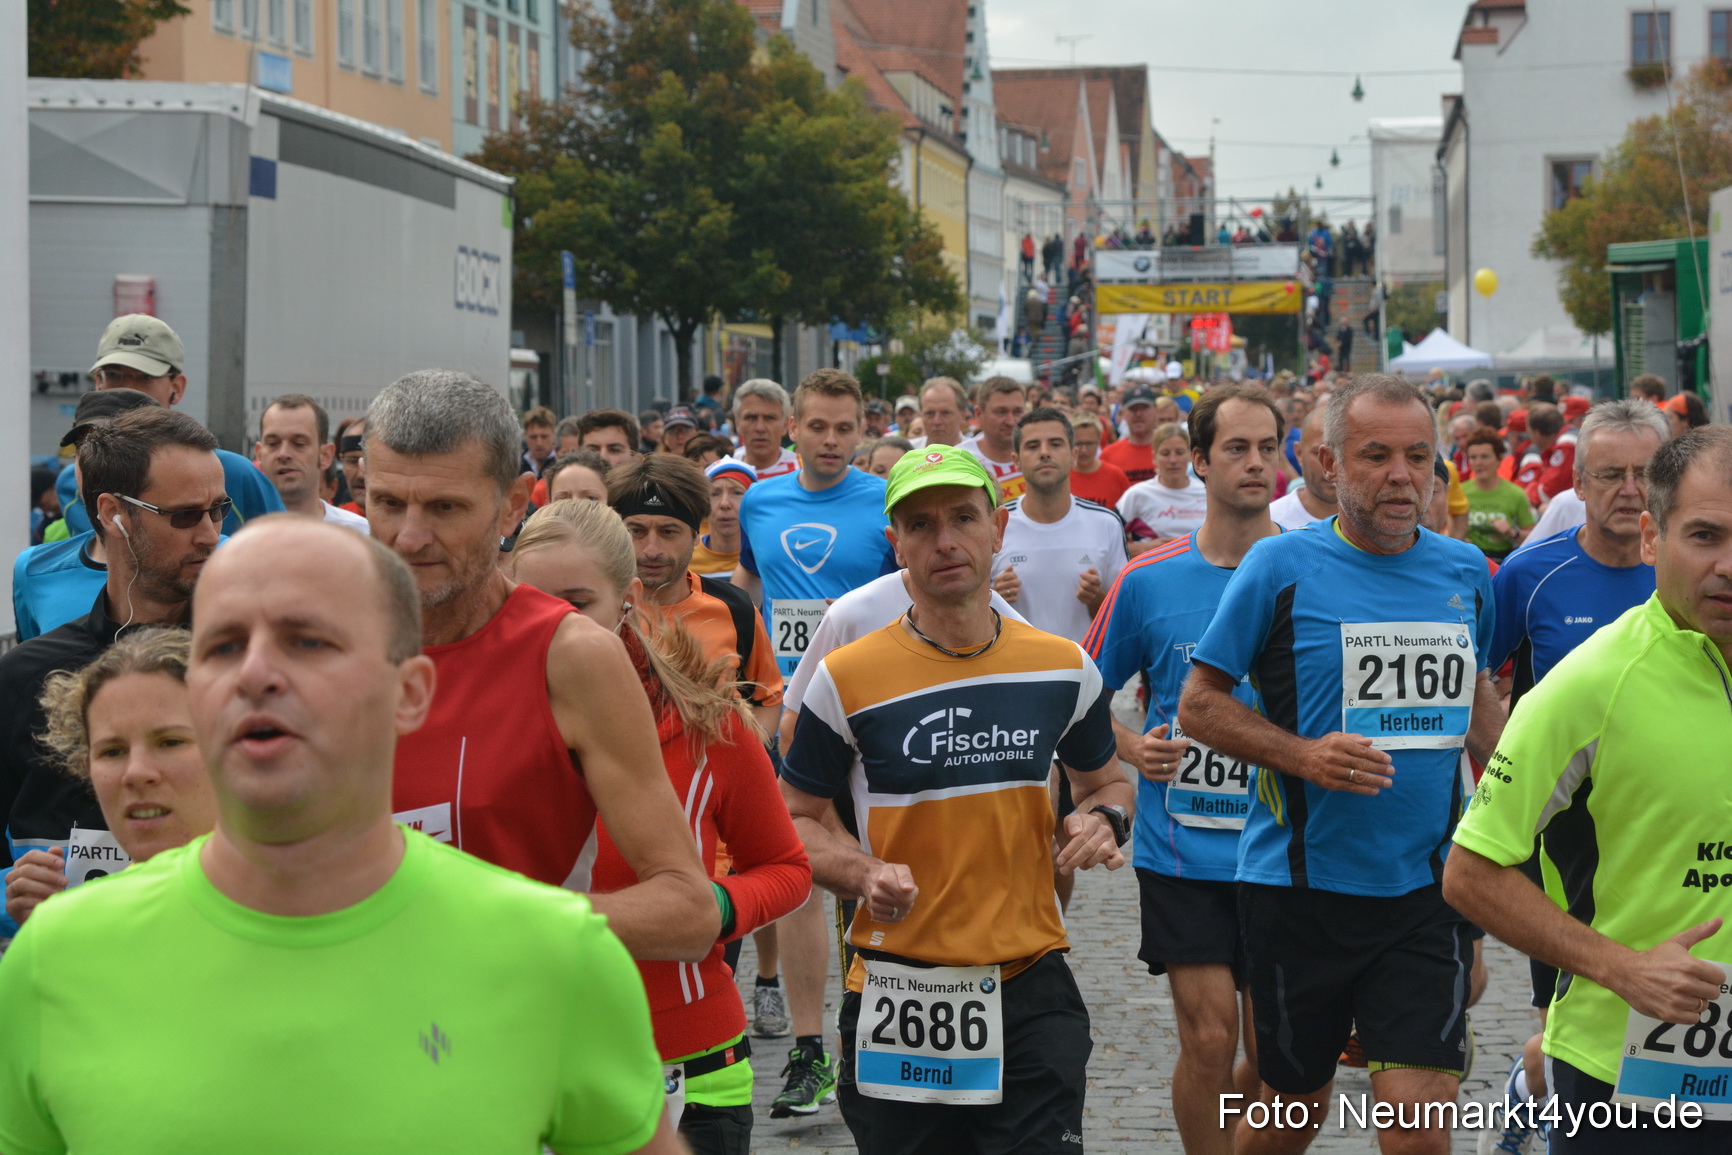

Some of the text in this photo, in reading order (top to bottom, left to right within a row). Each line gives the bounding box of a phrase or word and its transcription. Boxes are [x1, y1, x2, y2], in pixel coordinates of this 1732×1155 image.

[455, 245, 500, 316] BOCK
[1163, 289, 1232, 307] START
[773, 607, 822, 617] PARTL Neum
[1574, 616, 1593, 624] JAKO
[779, 620, 821, 652] 28
[1345, 635, 1453, 648] PARTL Neumarkt
[1358, 653, 1465, 701] 2160
[1348, 698, 1354, 707] C
[1380, 712, 1444, 732] Herbert
[931, 724, 1040, 756] Fischer
[943, 750, 1034, 768] AUTOMOBILE
[1179, 745, 1249, 789] 264
[1492, 750, 1513, 766] ter-
[1191, 796, 1249, 815] Matthia
[70, 844, 124, 861] PARTL
[1697, 841, 1732, 861] Klo
[1682, 868, 1732, 893] Apo
[868, 973, 974, 993] PARTL Neumarkt
[871, 996, 988, 1051] 2686
[861, 1040, 867, 1049] B
[1629, 1045, 1637, 1055] B
[901, 1061, 953, 1085] Bernd
[1680, 1073, 1729, 1097] Rudi
